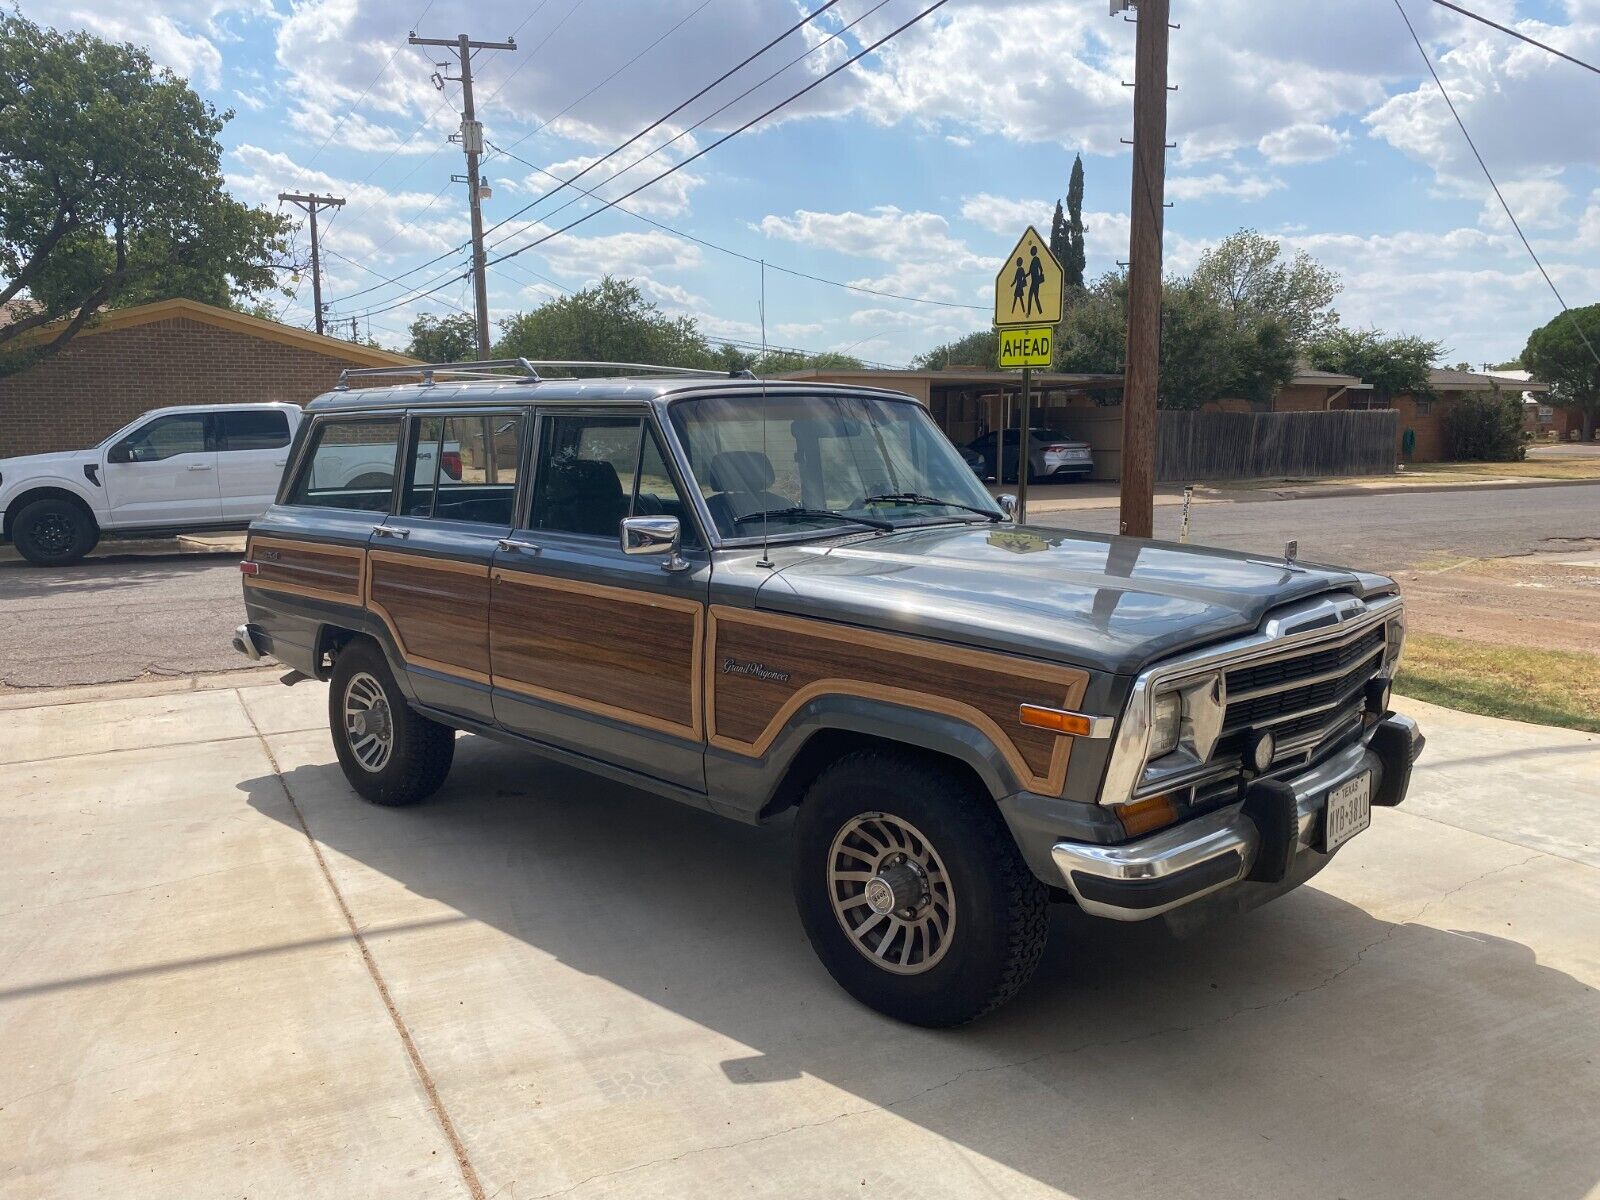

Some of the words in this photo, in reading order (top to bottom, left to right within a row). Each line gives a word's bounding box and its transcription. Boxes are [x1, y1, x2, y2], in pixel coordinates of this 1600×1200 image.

[1002, 338, 1049, 357] AHEAD
[722, 658, 750, 674] Grand
[750, 662, 789, 681] Wagoneer
[1341, 782, 1359, 798] TEXAS
